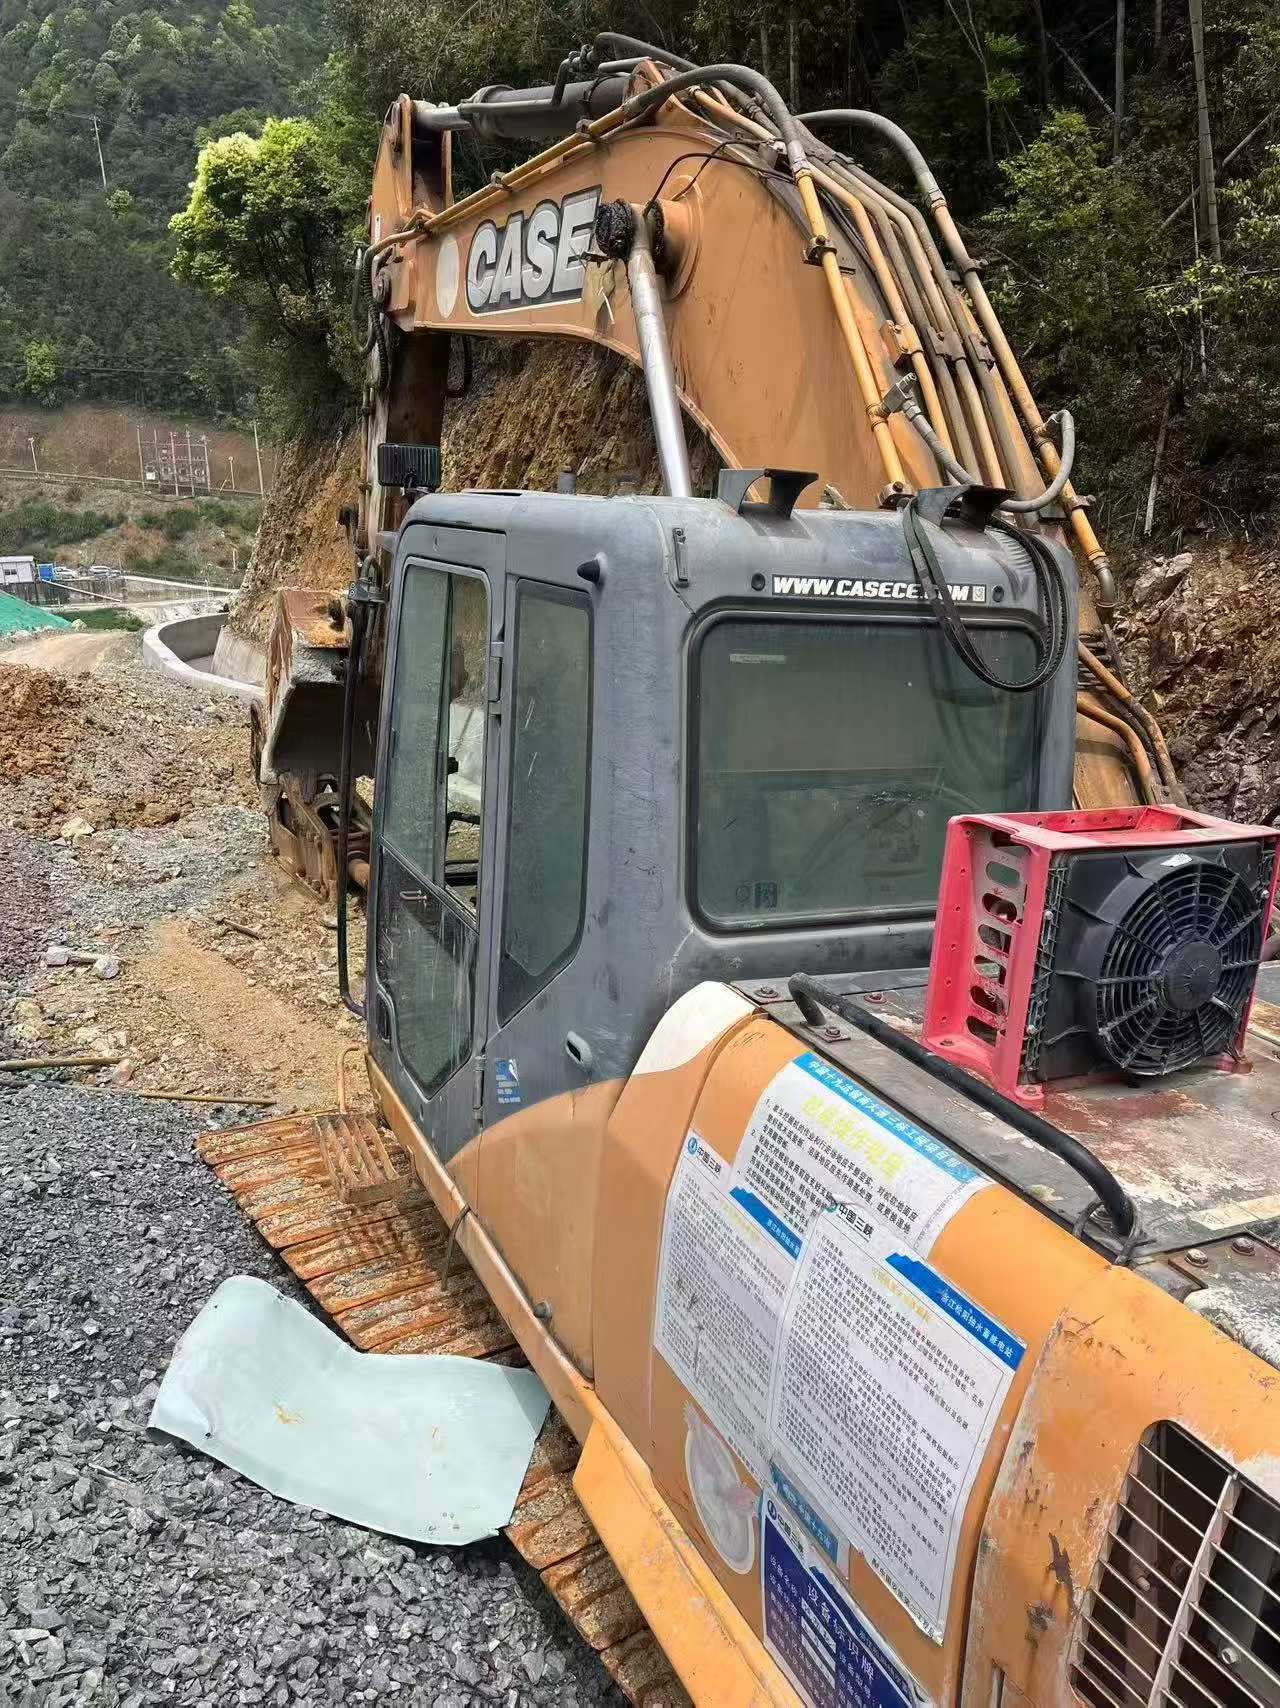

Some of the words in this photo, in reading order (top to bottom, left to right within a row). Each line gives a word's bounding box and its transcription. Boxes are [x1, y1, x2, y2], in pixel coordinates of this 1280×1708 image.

[467, 185, 602, 312] CASE
[772, 576, 970, 602] WWW.CASECE.M
[838, 1203, 874, 1238] 中国三峡
